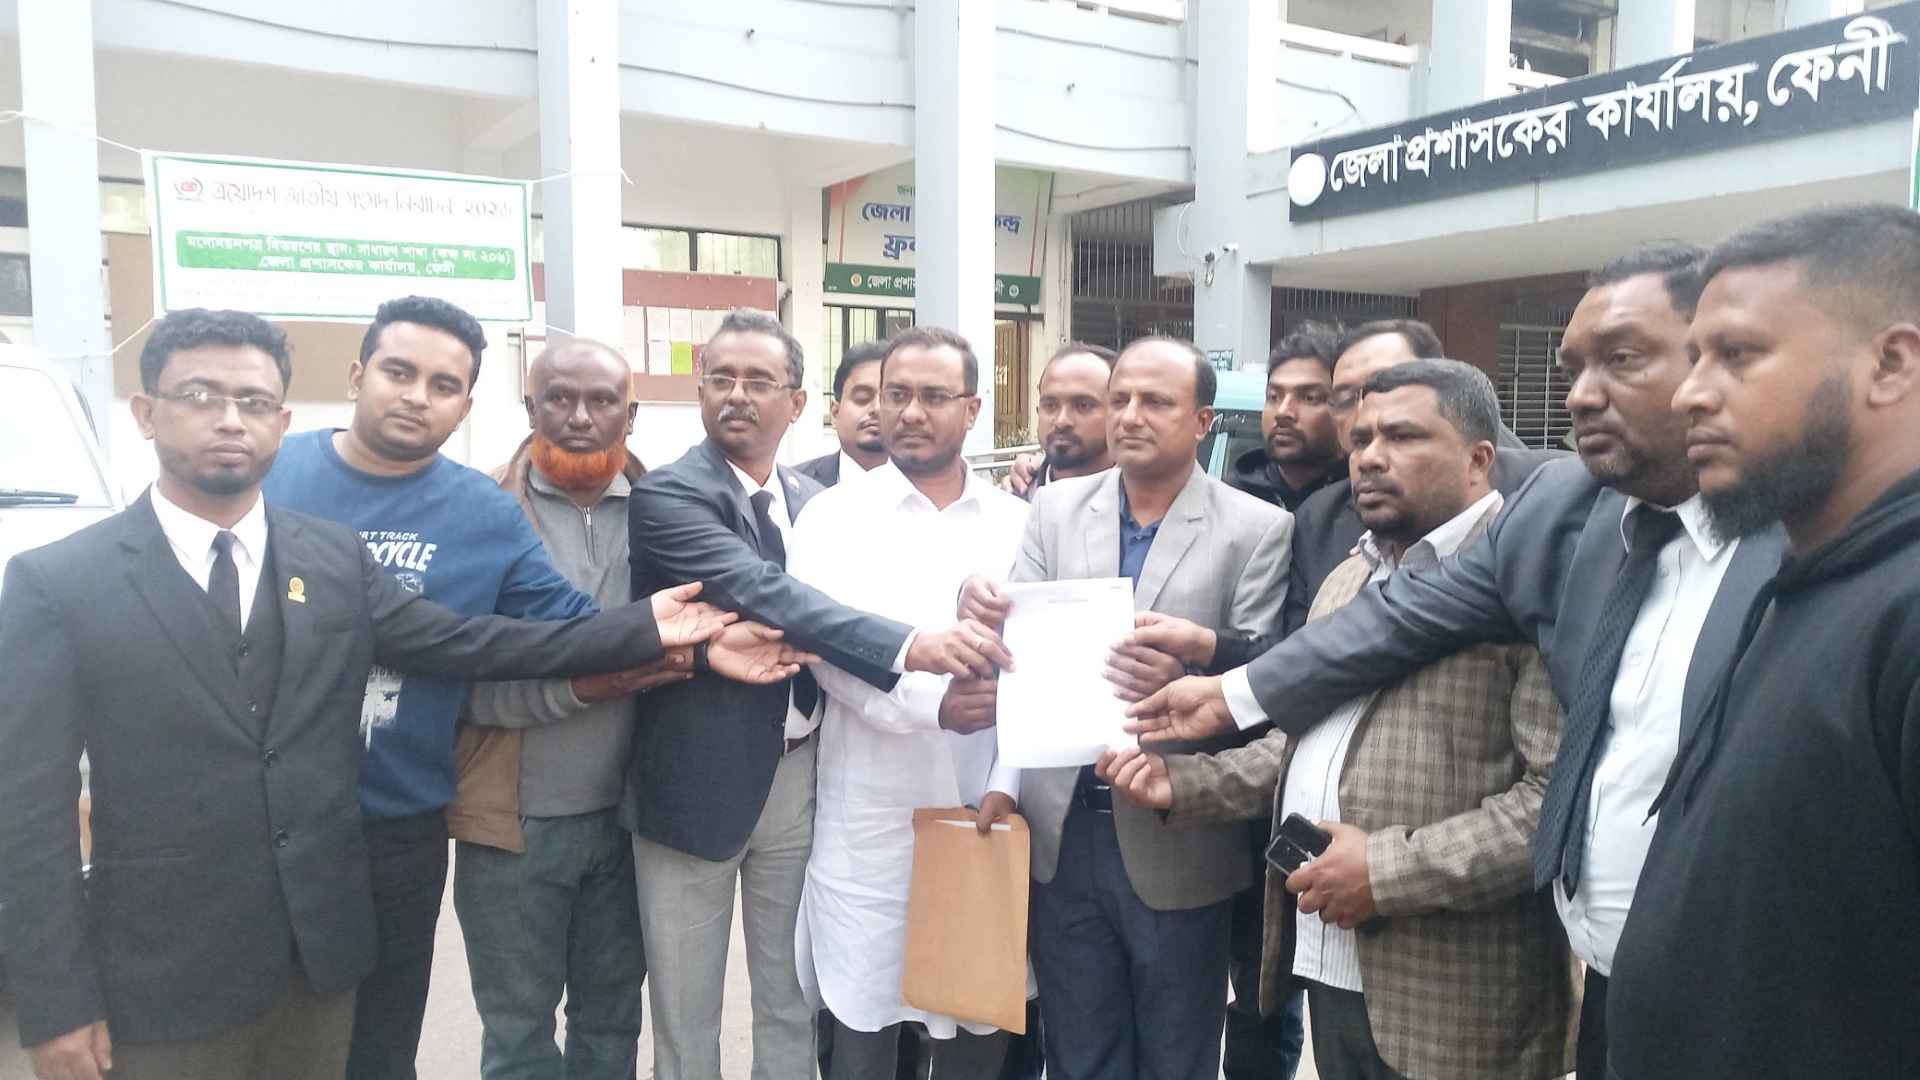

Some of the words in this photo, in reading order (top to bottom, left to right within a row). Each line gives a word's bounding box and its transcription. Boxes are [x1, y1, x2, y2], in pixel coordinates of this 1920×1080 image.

[1330, 134, 1404, 192] জেলা
[1404, 101, 1578, 177] প্রশাসকের
[1582, 57, 1759, 141] কার্যালয়,
[1767, 16, 1907, 106] ফেনী
[861, 202, 912, 223] জেলা
[380, 531, 419, 541] TRACK
